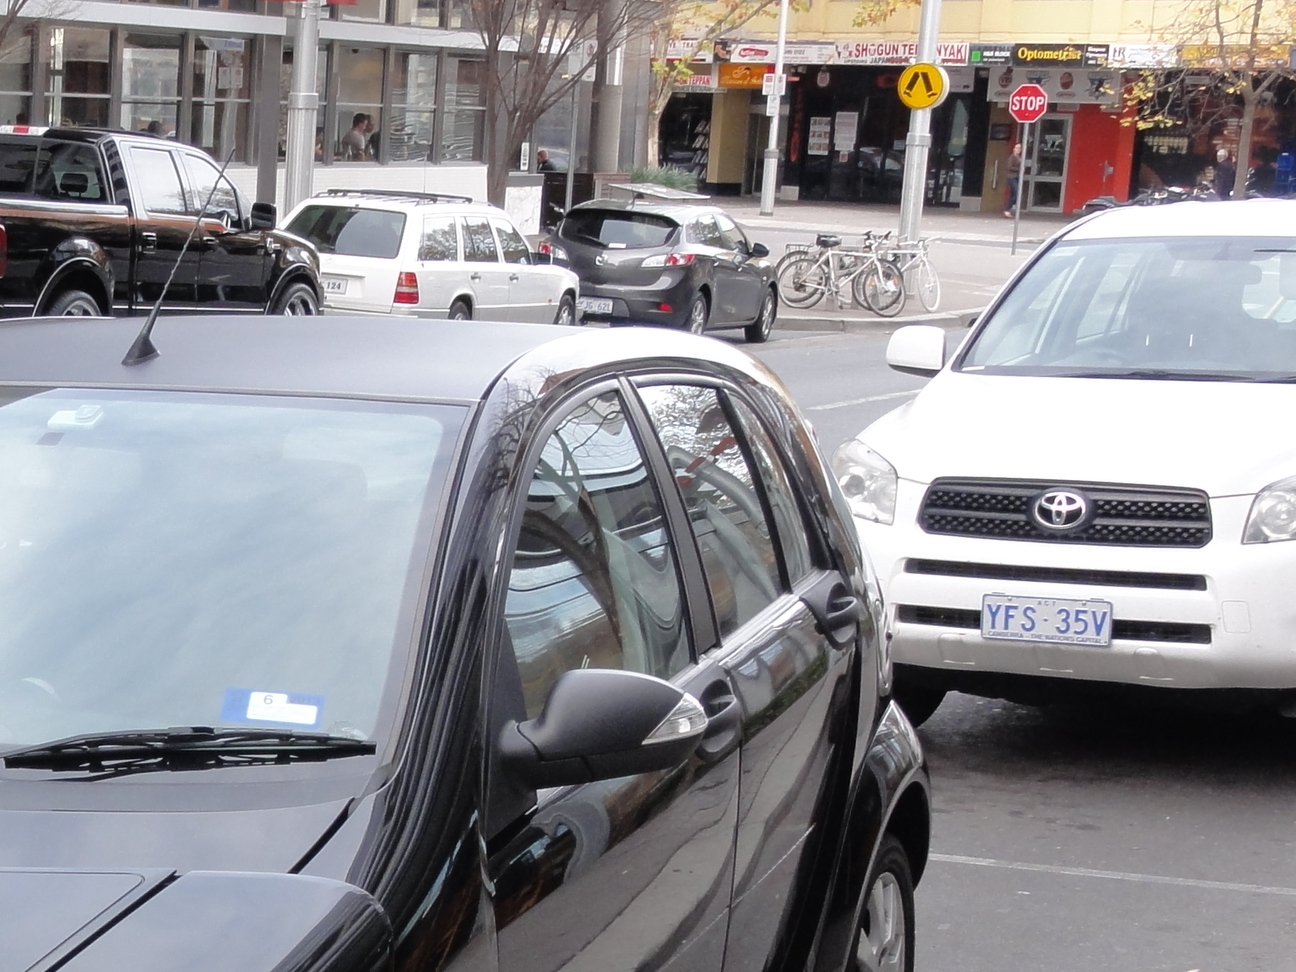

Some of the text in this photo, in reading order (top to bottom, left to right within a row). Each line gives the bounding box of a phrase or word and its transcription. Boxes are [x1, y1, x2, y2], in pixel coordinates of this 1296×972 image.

[855, 43, 968, 61] SHOGUN TENYAKI
[1012, 96, 1045, 111] STOP
[1037, 600, 1057, 608] ACT
[987, 630, 1024, 639] CANBERRA
[1030, 633, 1045, 641] THE
[263, 694, 274, 705] 6
